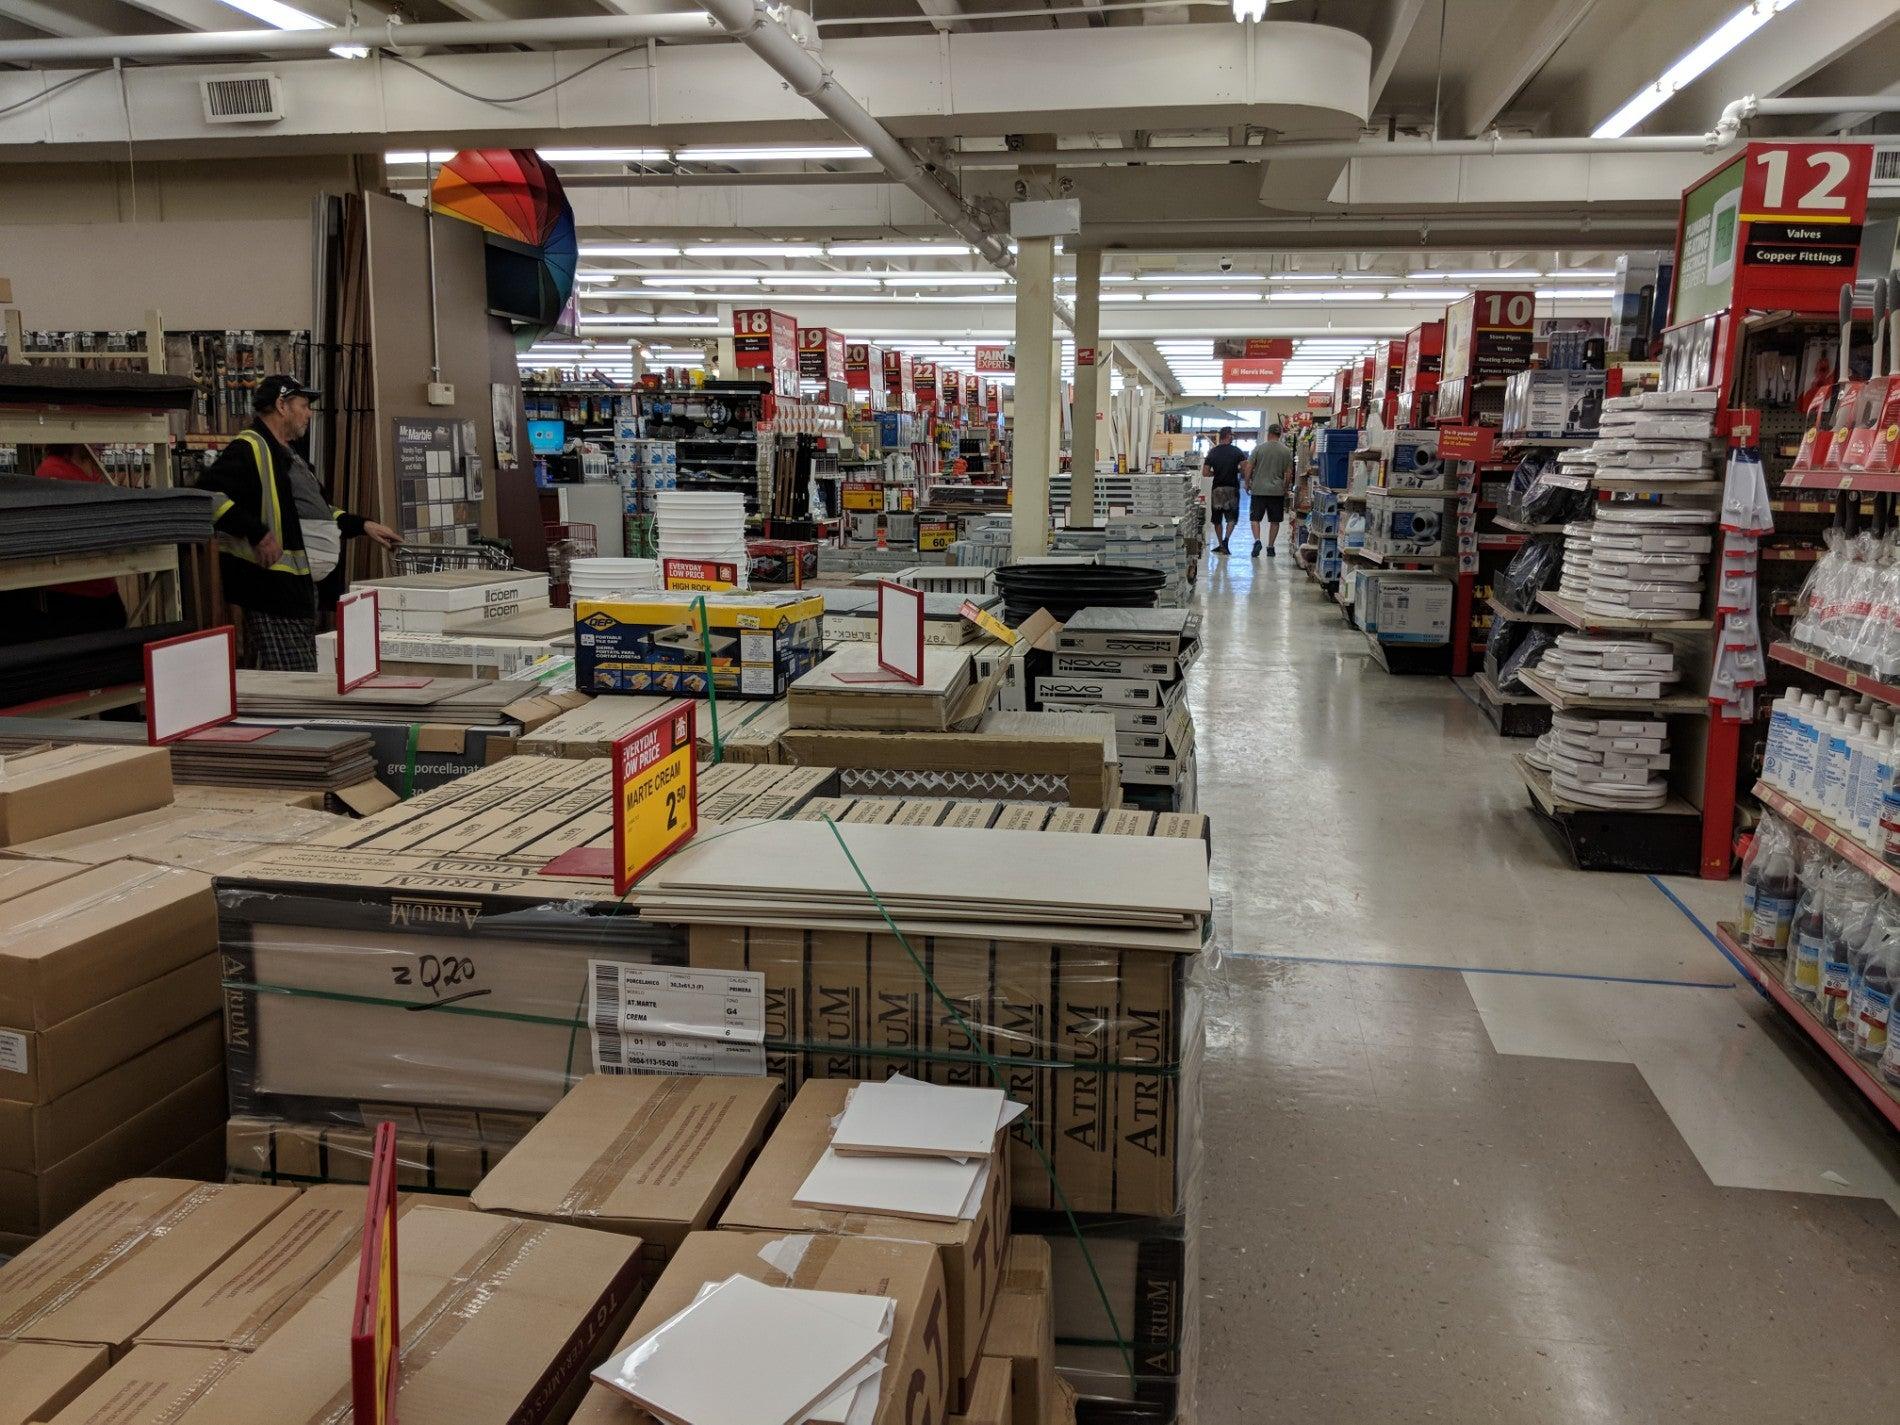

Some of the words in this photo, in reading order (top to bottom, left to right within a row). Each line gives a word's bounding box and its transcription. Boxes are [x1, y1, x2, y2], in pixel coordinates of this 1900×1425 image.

[1757, 150, 1851, 209] 12
[1786, 228, 1821, 239] Valves
[1756, 250, 1796, 263] Copper
[1799, 251, 1842, 264] Fittings
[1485, 295, 1532, 325] 10
[738, 312, 768, 333] 18
[799, 330, 823, 348] 19
[1506, 334, 1521, 342] Pipes
[846, 346, 866, 362] 20
[978, 351, 1010, 361] PAINT
[1478, 356, 1501, 364] Heating
[914, 364, 934, 378] 22
[977, 361, 1011, 369] EXPERTS
[942, 372, 957, 385] 23
[408, 428, 433, 441] Marble
[669, 562, 702, 572] EVERYDAY
[669, 570, 684, 578] LOW
[685, 570, 705, 579] PRICE
[672, 583, 690, 591] HIGH
[691, 584, 711, 592] ROCK
[490, 589, 519, 602] coem
[489, 604, 519, 618] coem
[925, 635, 946, 643] 787
[1106, 644, 1171, 652] NOVO
[1059, 658, 1122, 668] NOVO
[1040, 684, 1103, 693] NOVO
[624, 761, 639, 780] OW
[639, 743, 661, 770] PRICE
[387, 763, 406, 776] gre
[626, 779, 653, 812] MARTE
[654, 760, 681, 791] CREAM
[390, 903, 483, 930] ATRIUM
[222, 954, 249, 1047] ARIUM
[627, 1000, 657, 1008] AT.MARTE
[819, 985, 850, 1079] RUM
[629, 1058, 679, 1068] 0804-113-15-030
[1064, 1003, 1099, 1151] ATRUM
[1125, 1007, 1161, 1157] ATRUM
[587, 1292, 619, 1344] TGT
